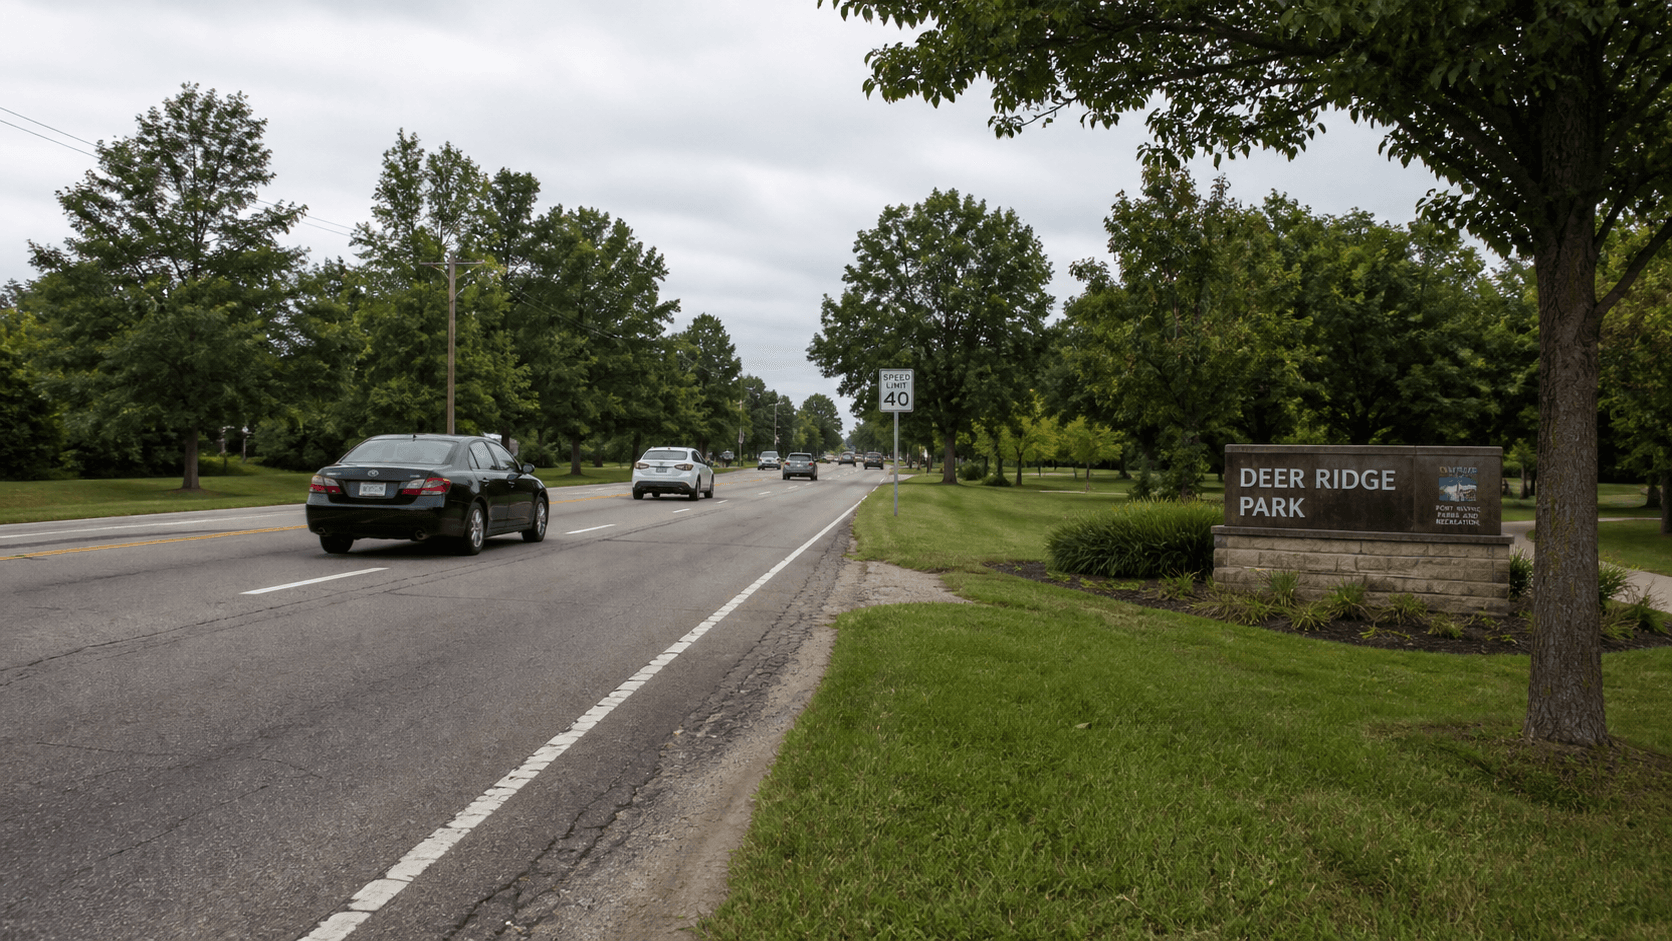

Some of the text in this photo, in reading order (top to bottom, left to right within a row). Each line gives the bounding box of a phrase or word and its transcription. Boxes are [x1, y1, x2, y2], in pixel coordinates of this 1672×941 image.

[883, 373, 910, 381] SPEED
[884, 391, 909, 406] 40
[1240, 468, 1396, 491] DEER RIDGE
[1239, 496, 1306, 518] PARK
